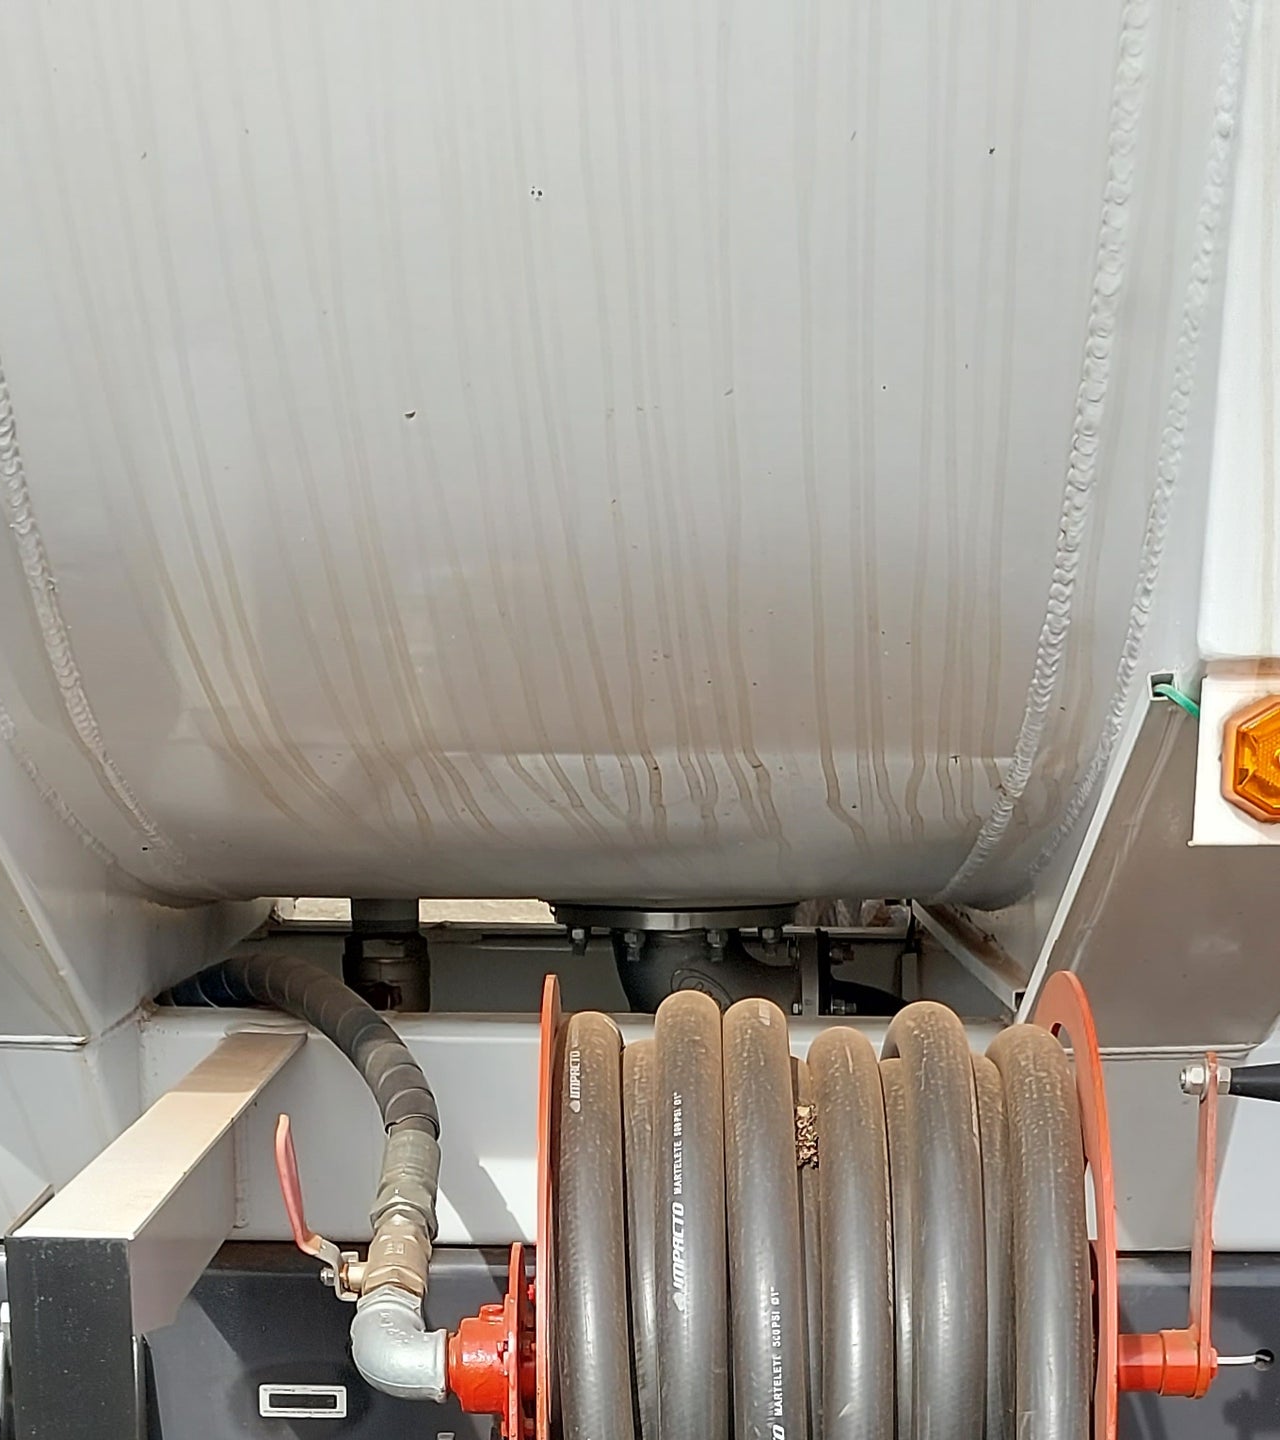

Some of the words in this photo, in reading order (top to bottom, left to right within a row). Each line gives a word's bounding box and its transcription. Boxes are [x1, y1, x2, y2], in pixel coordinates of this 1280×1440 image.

[569, 1050, 581, 1099] IMPACTO
[673, 1140, 683, 1196] MARTELETE
[672, 1201, 686, 1290] IMPACTO
